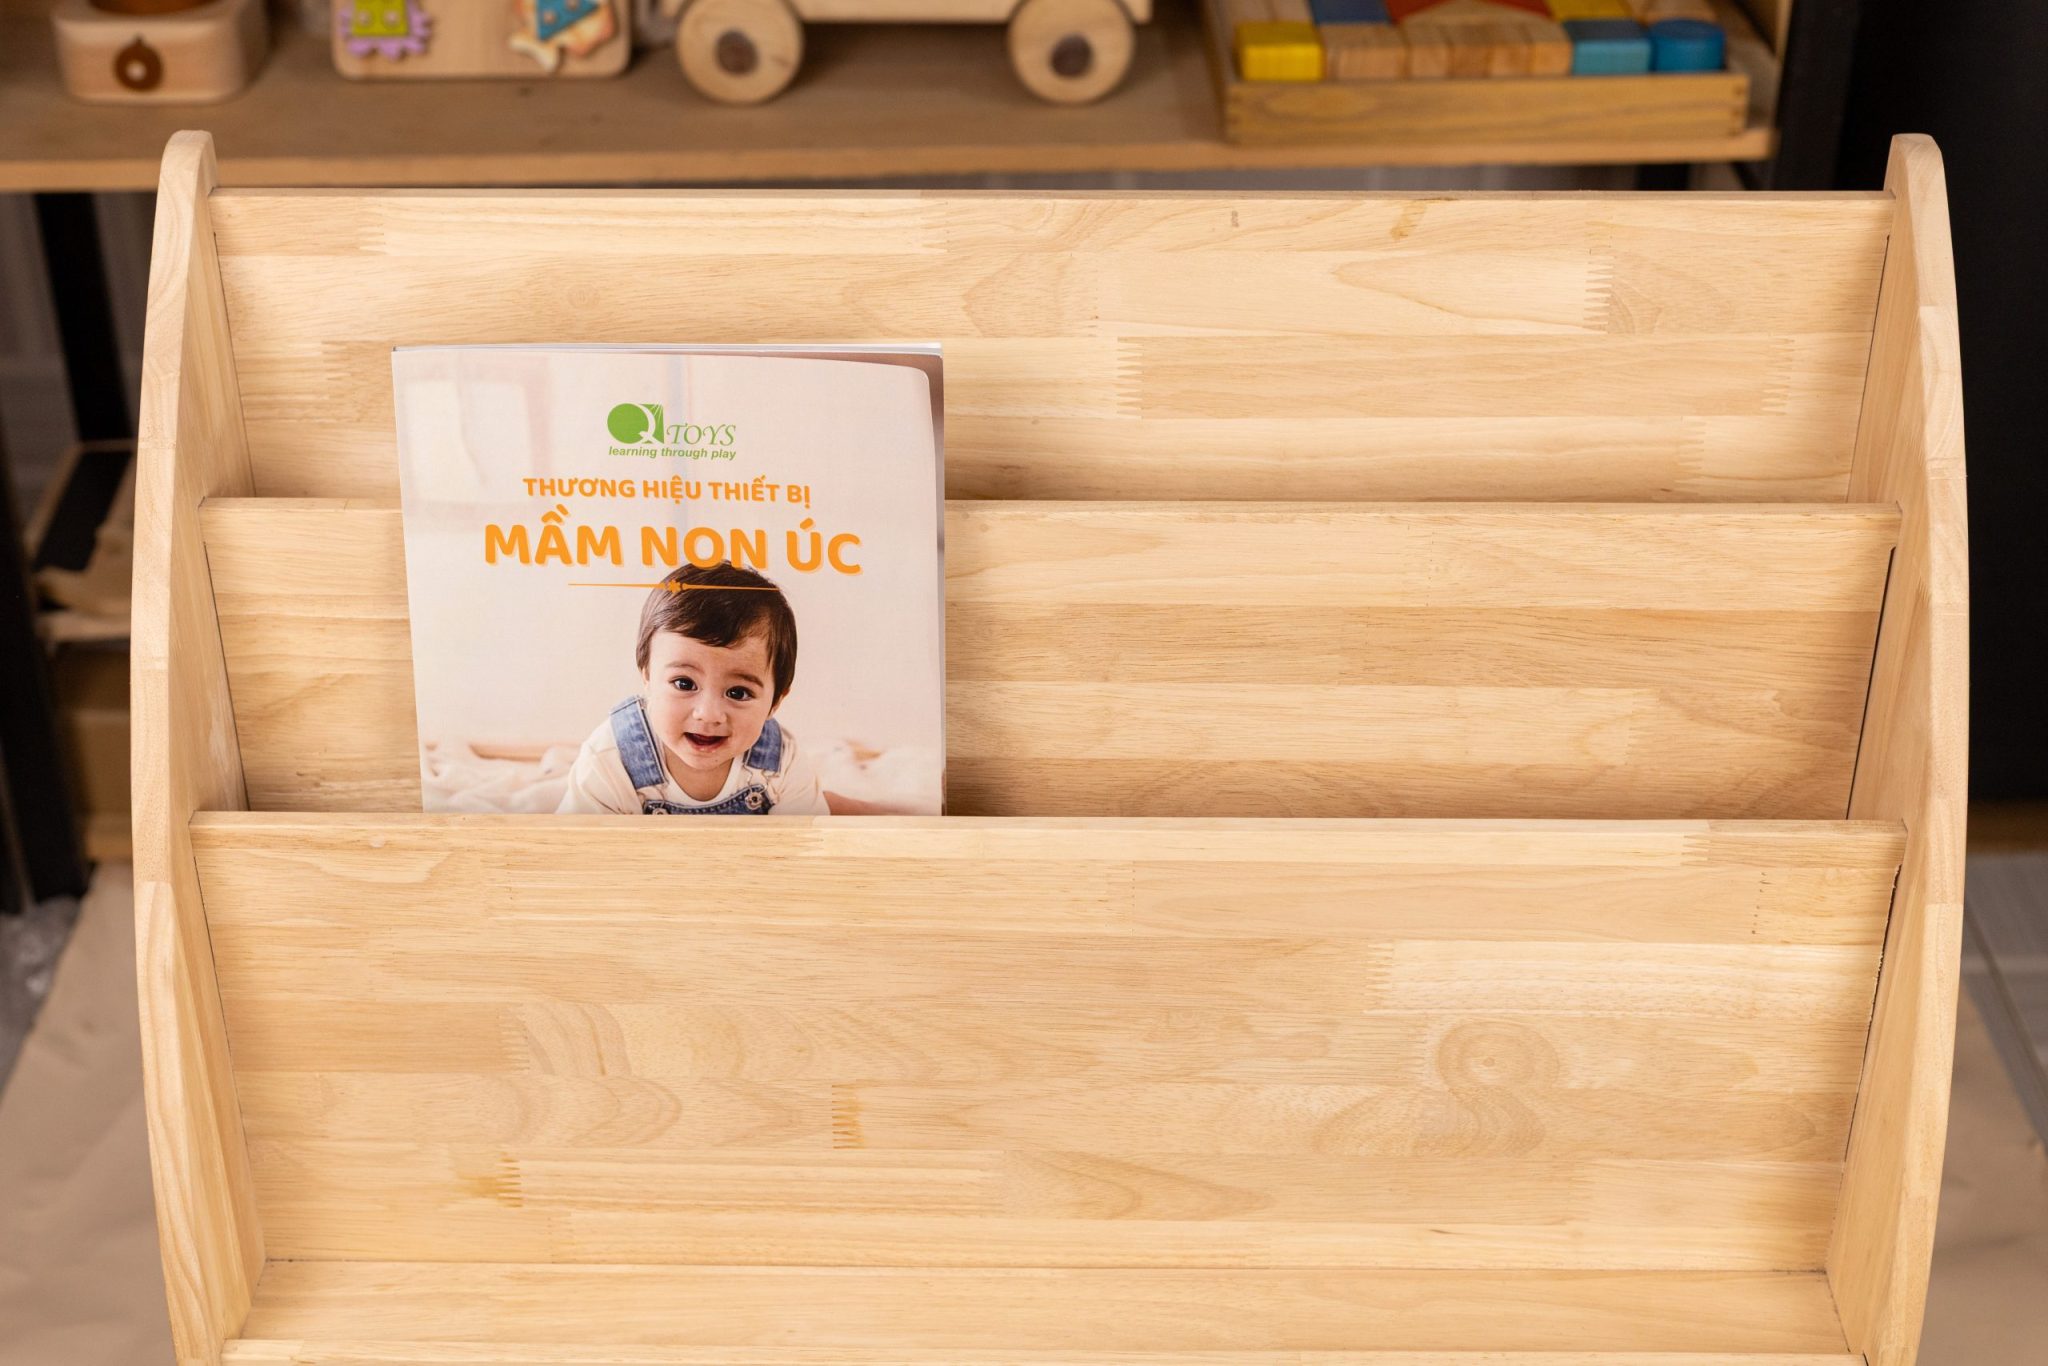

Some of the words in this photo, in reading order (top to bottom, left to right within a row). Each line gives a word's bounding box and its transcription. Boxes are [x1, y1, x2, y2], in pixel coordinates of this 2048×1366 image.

[667, 423, 737, 446] TOYS
[608, 446, 657, 459] learning
[661, 447, 708, 460] through
[711, 449, 737, 461] play
[523, 477, 636, 498] THƯƠNG
[642, 475, 701, 504] HIỆU
[708, 475, 780, 503] THIẾT
[786, 484, 811, 509] BỊ
[484, 504, 622, 567] MẦM
[641, 526, 767, 570] NON
[786, 517, 863, 576] ÚC
